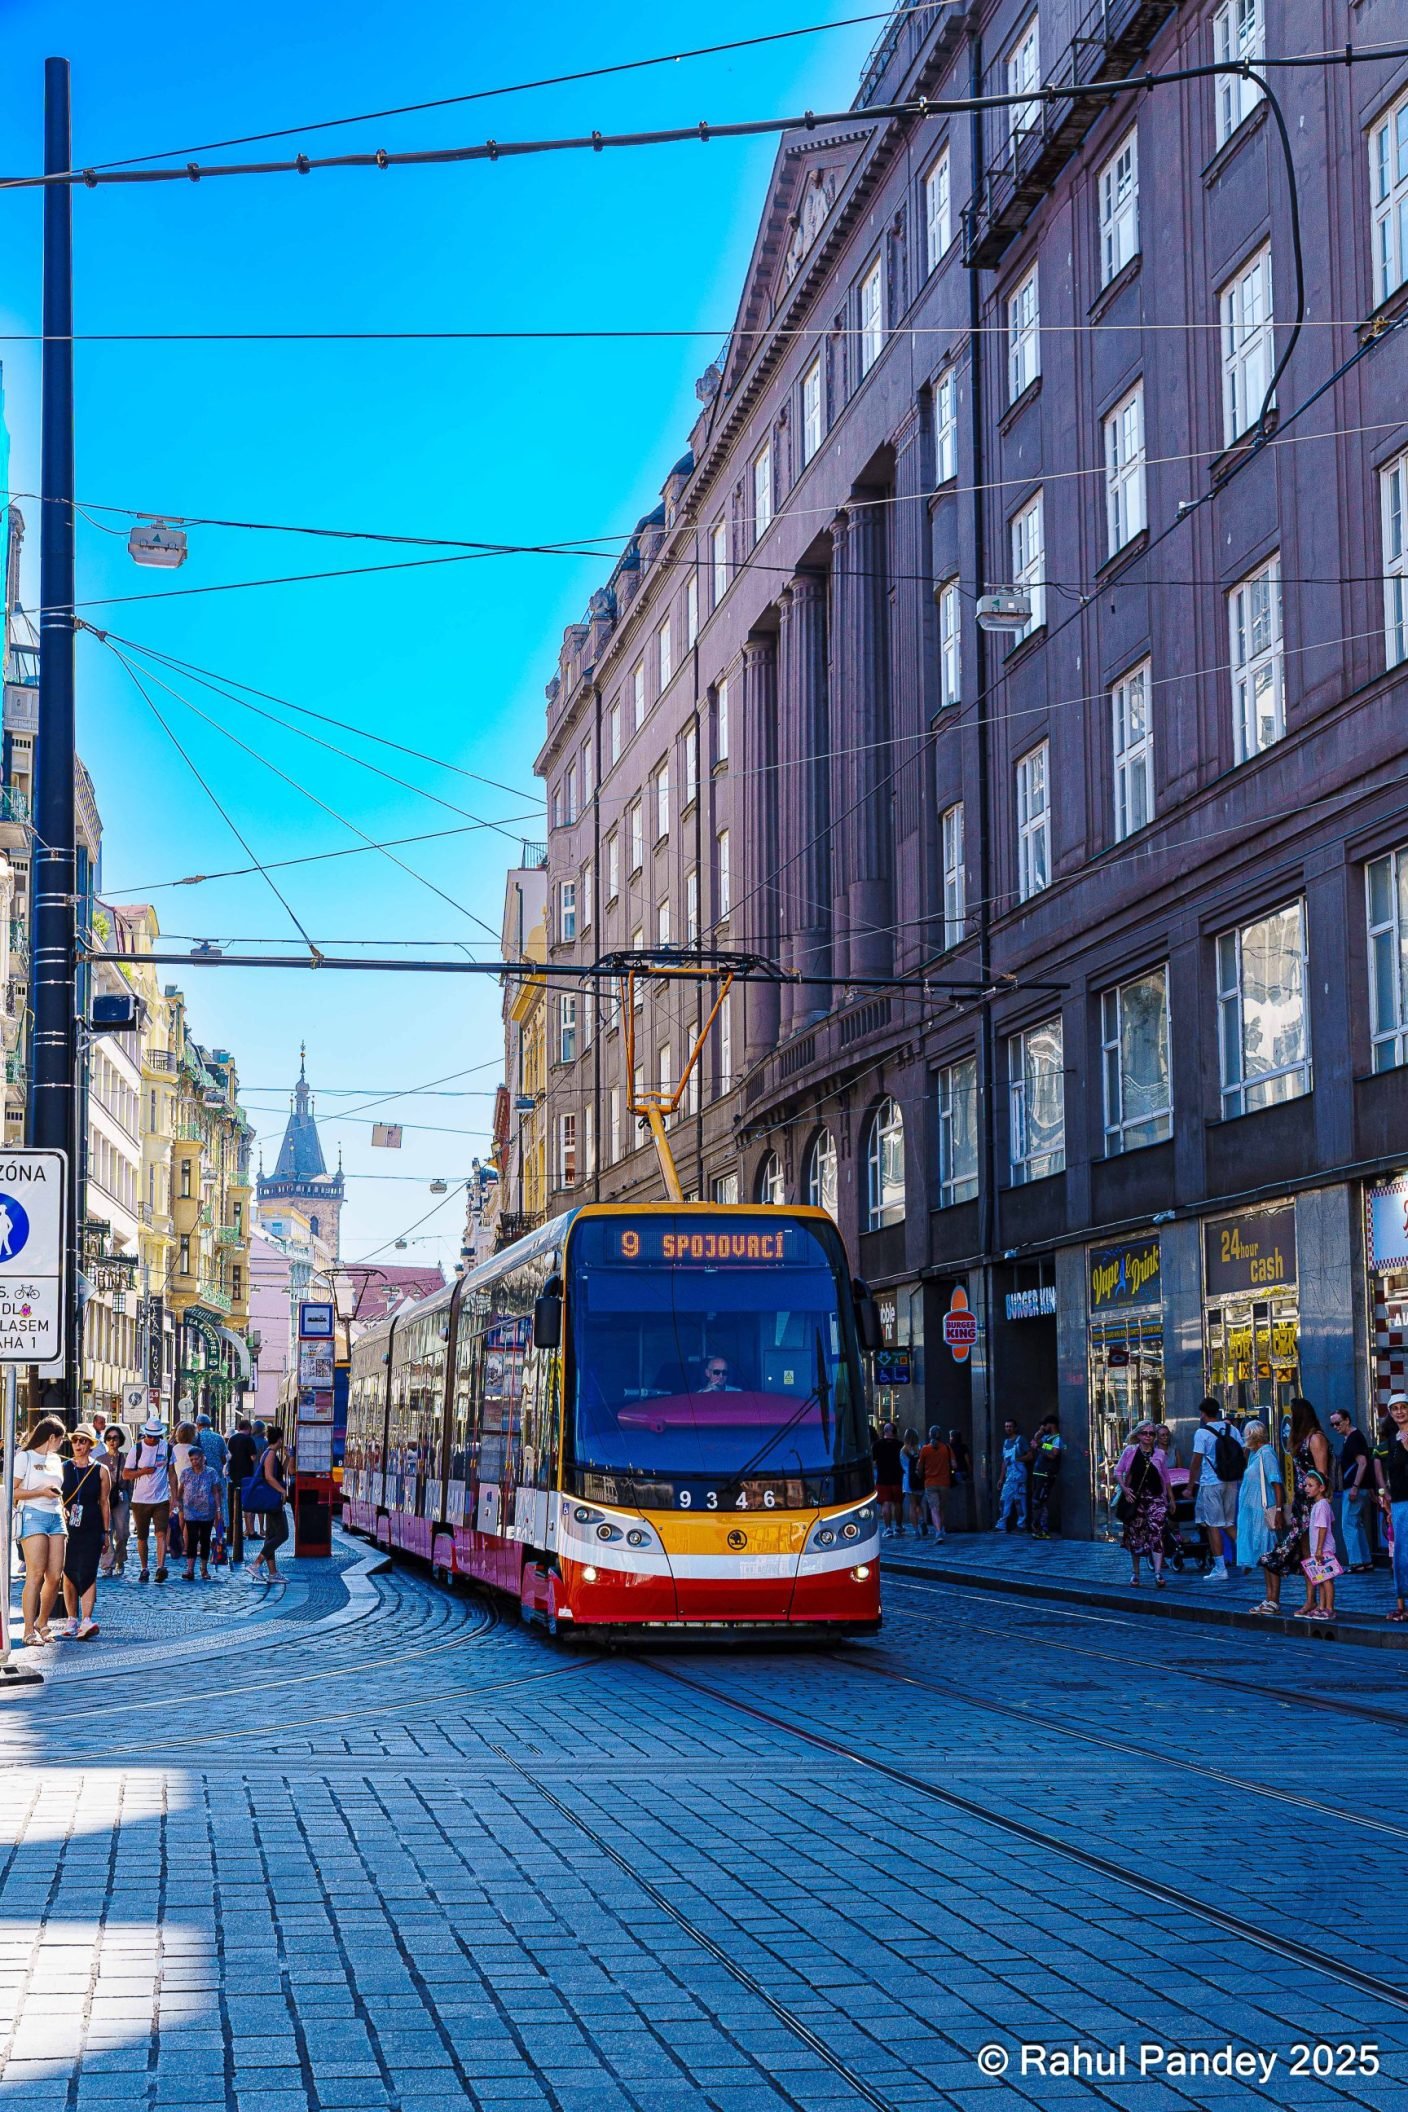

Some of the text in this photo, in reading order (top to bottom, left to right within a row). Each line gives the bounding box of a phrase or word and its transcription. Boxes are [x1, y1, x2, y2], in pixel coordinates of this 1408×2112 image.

[621, 1231, 784, 1258] 9 SPOJOVACÍ
[1220, 1228, 1259, 1263] 24 hour
[1092, 1260, 1119, 1305] Vape
[1131, 1244, 1159, 1295] Drink
[1250, 1248, 1284, 1283] cash
[2, 1303, 20, 1315] DL
[880, 1301, 896, 1324] bble
[1005, 1286, 1057, 1320] BURGER KIN
[185, 1316, 198, 1326] TEA
[203, 1327, 217, 1355] COFFEE
[946, 1321, 976, 1329] BURGER
[946, 1328, 976, 1339] KING
[31, 1336, 36, 1349] 1
